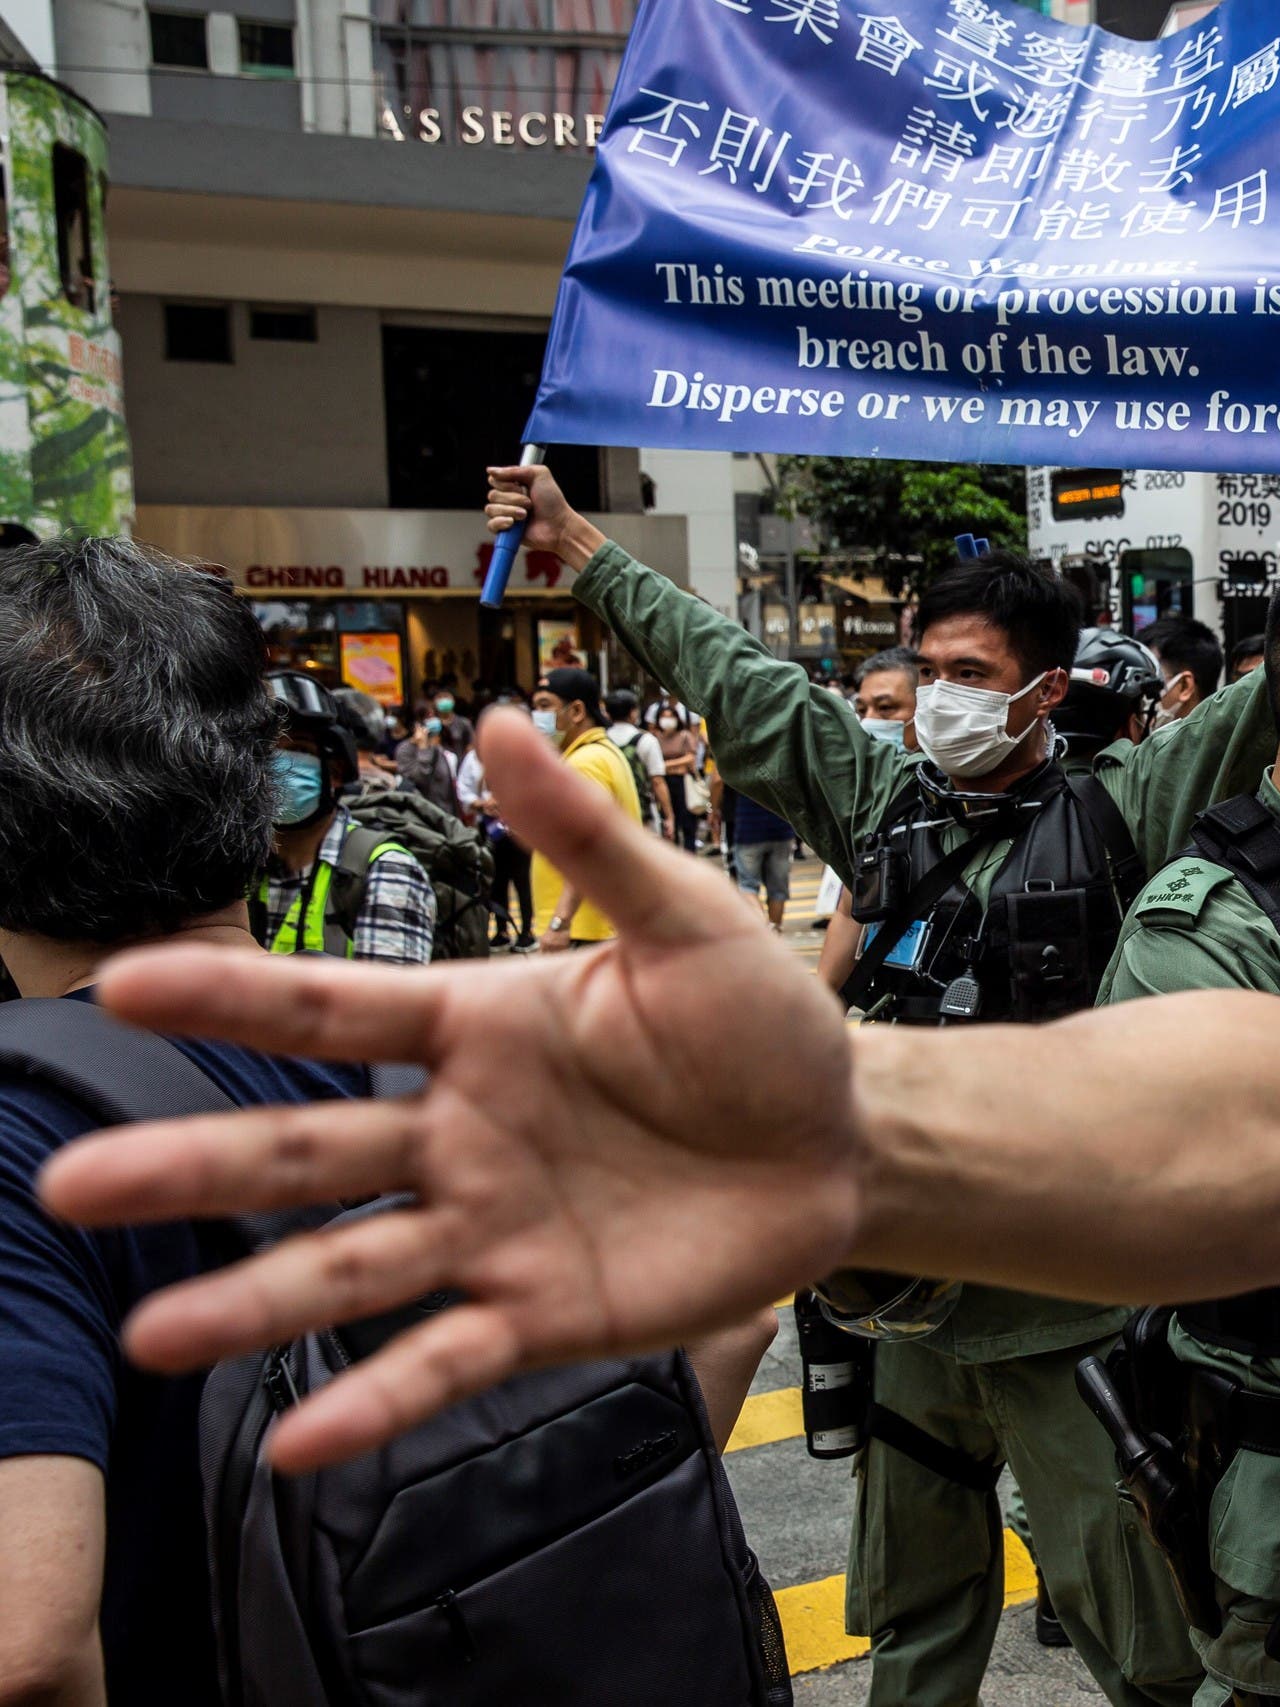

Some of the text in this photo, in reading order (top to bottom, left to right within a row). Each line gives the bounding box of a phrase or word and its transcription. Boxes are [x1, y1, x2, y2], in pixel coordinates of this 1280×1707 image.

[936, 0, 1224, 96] 警察警告
[890, 106, 1202, 193] 請即散去
[796, 234, 950, 271] Police
[655, 263, 745, 306] This
[757, 270, 924, 323] meeting
[935, 283, 986, 313] or
[996, 279, 1238, 327] procession
[796, 326, 1201, 377] breach of the law.
[646, 369, 845, 423] Disperse
[857, 391, 911, 420] or
[922, 395, 985, 423] we
[996, 397, 1101, 438] may
[1115, 399, 1192, 432] use
[1144, 471, 1185, 490] 2020
[1217, 501, 1271, 527] 2019
[246, 566, 344, 588] CHENG
[363, 566, 449, 588] HIANG
